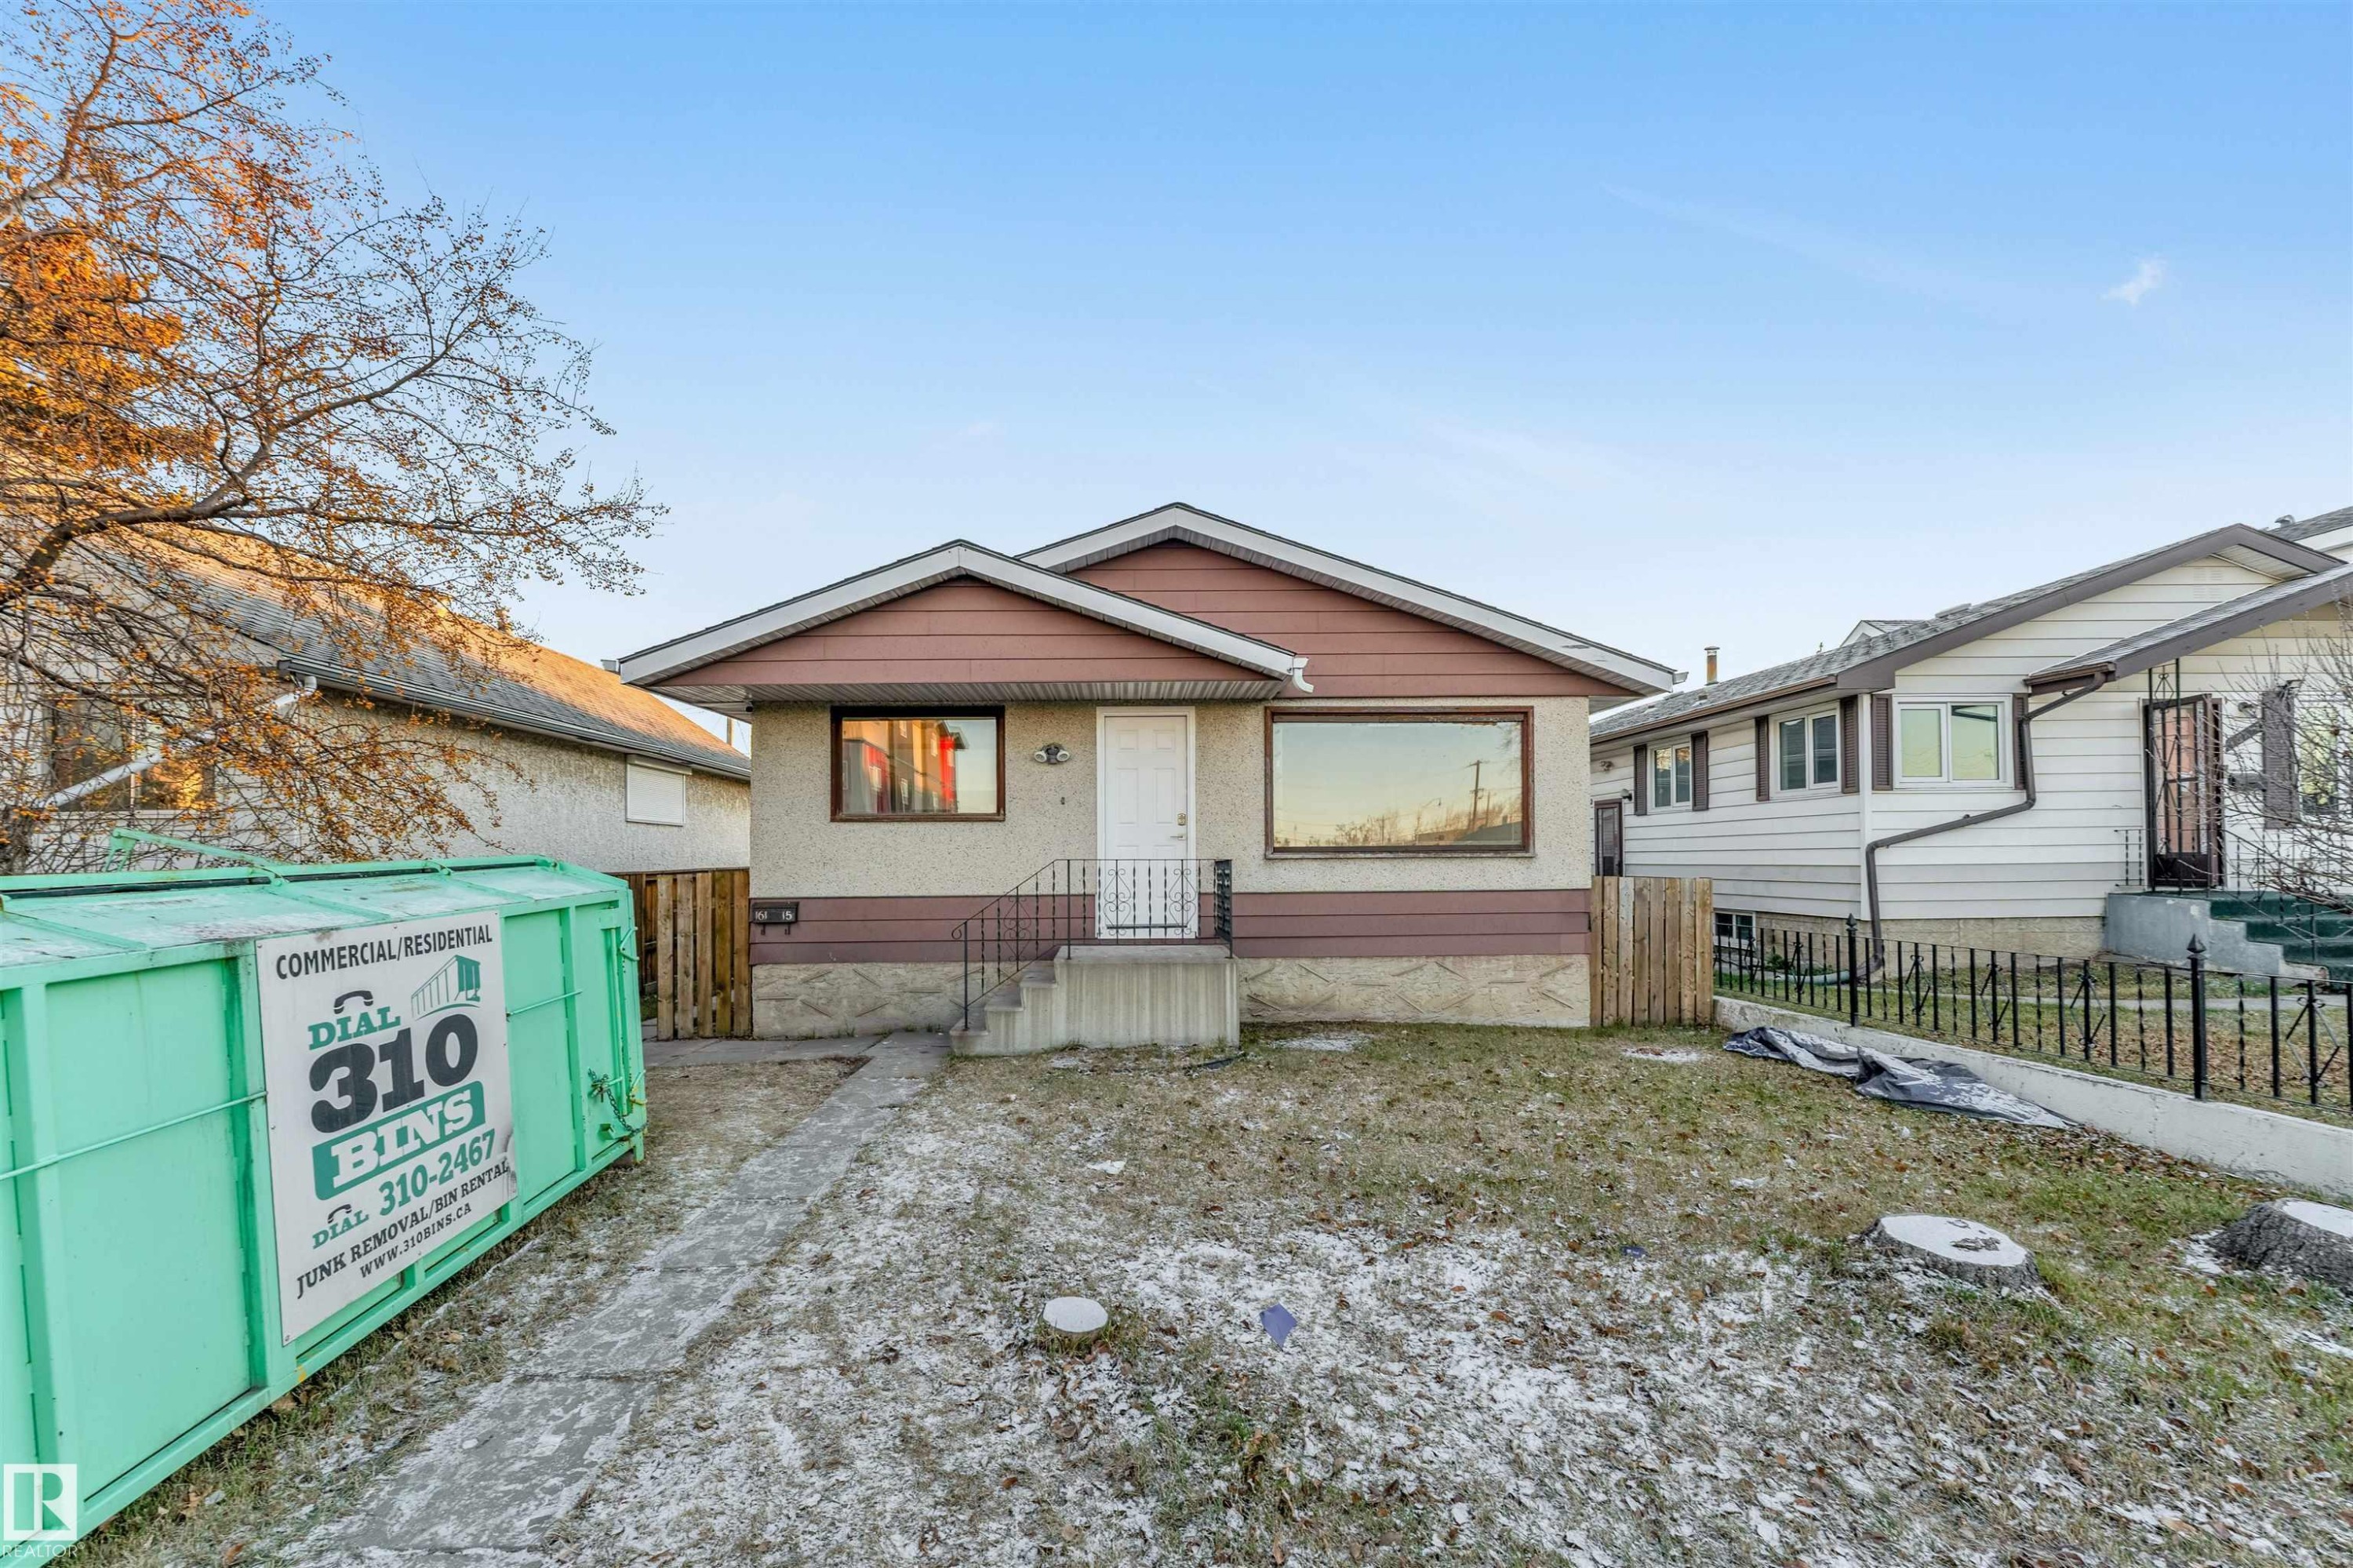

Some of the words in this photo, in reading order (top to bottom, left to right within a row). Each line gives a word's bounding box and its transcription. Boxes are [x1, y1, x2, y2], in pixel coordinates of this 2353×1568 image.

[276, 925, 493, 980] COMMERCIAL/RESIDENTIAL
[307, 1006, 401, 1050] DIAL
[309, 1013, 478, 1133] 310
[330, 1090, 474, 1188] BINS
[296, 1252, 347, 1299] JUNK
[350, 1188, 458, 1264] REMOVAL/BIN
[461, 1160, 510, 1199] RENTAL
[312, 1210, 369, 1250] DIAL
[378, 1129, 496, 1216] 310-2467
[359, 1202, 472, 1279] WWW.310BINS.CA
